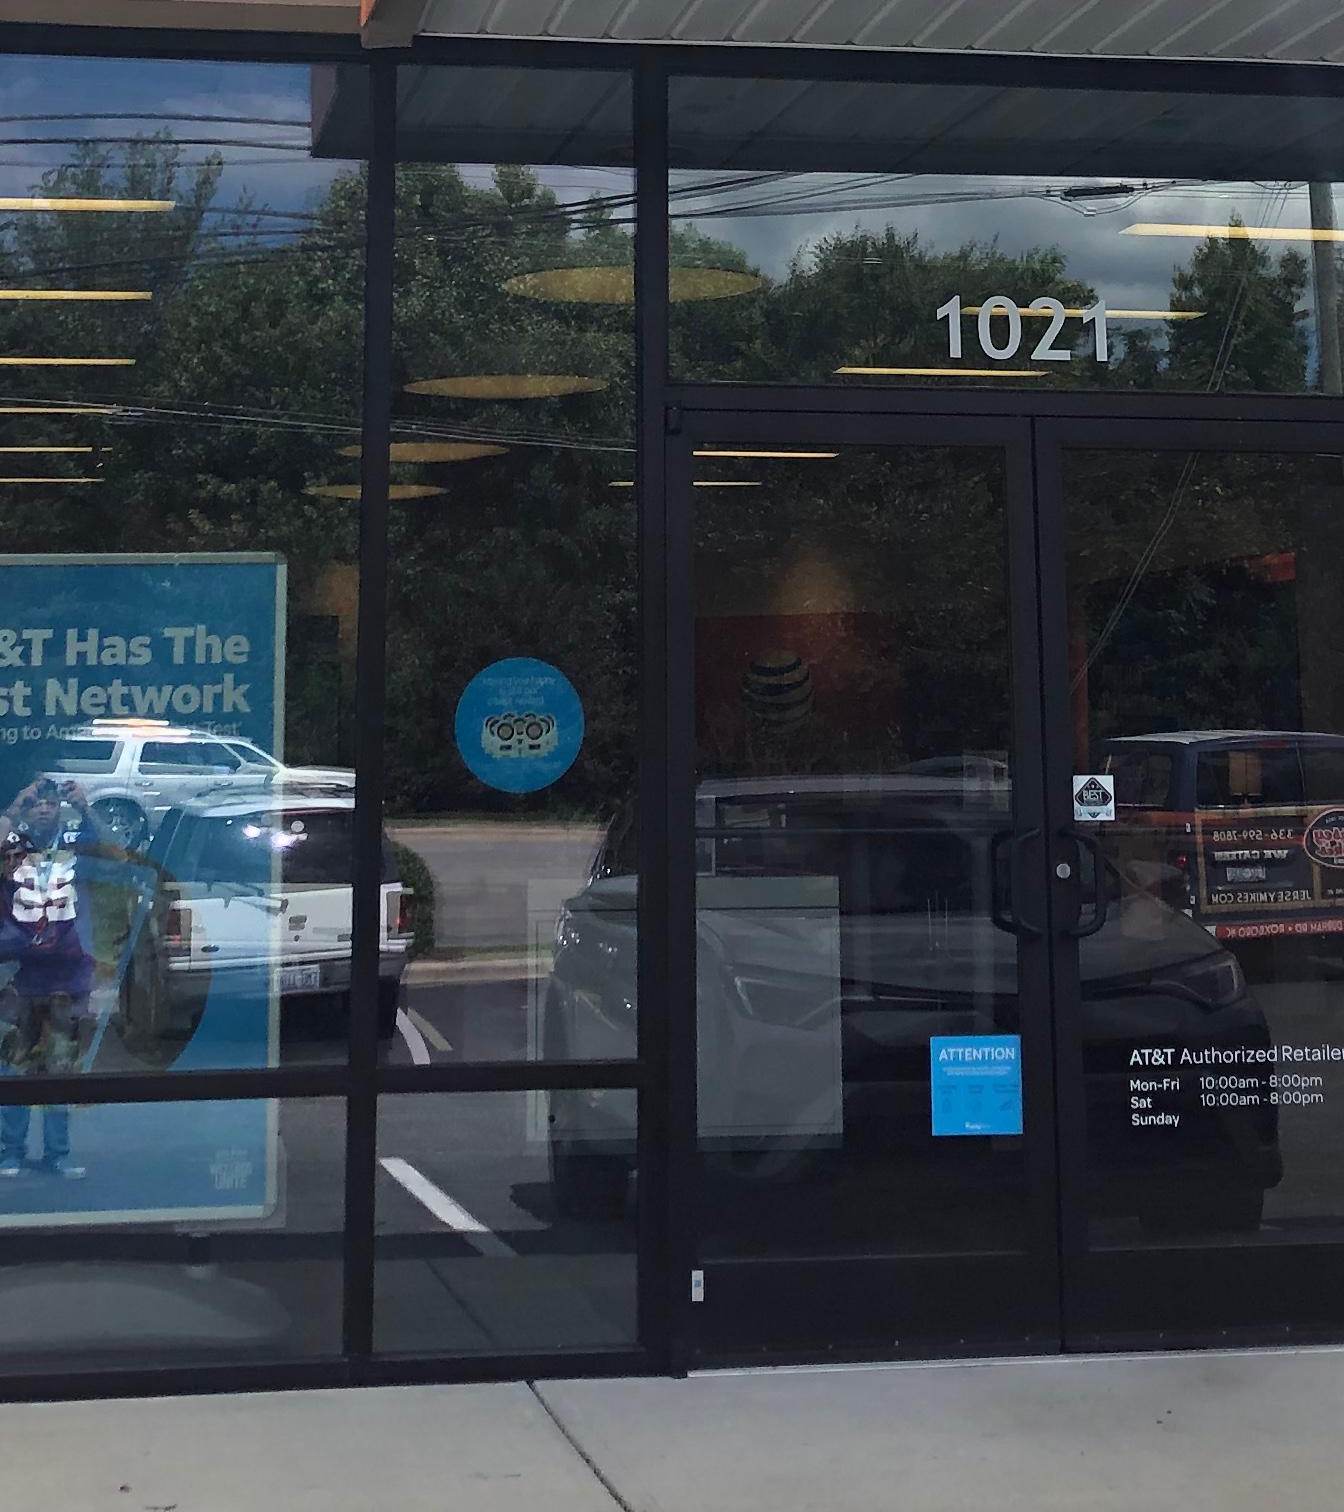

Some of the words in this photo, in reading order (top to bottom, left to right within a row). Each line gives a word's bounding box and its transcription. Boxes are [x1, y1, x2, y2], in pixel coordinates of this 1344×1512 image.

[936, 294, 1108, 362] 1021
[65, 627, 152, 667] Has
[162, 624, 251, 665] The
[45, 673, 252, 717] Network
[23, 725, 42, 741] to
[939, 1048, 1015, 1062] ATTENTION
[1129, 1048, 1175, 1066] AT&T
[1180, 1045, 1277, 1065] Authorized
[1129, 1078, 1180, 1092] Mon-Fri
[1199, 1076, 1259, 1090] 10:00am
[1269, 1074, 1323, 1090] 8:00pm
[1130, 1096, 1152, 1109] Sat
[1200, 1093, 1260, 1107] 10:00am
[1270, 1092, 1324, 1106] 8:00pm
[1131, 1113, 1180, 1127] Sunday
